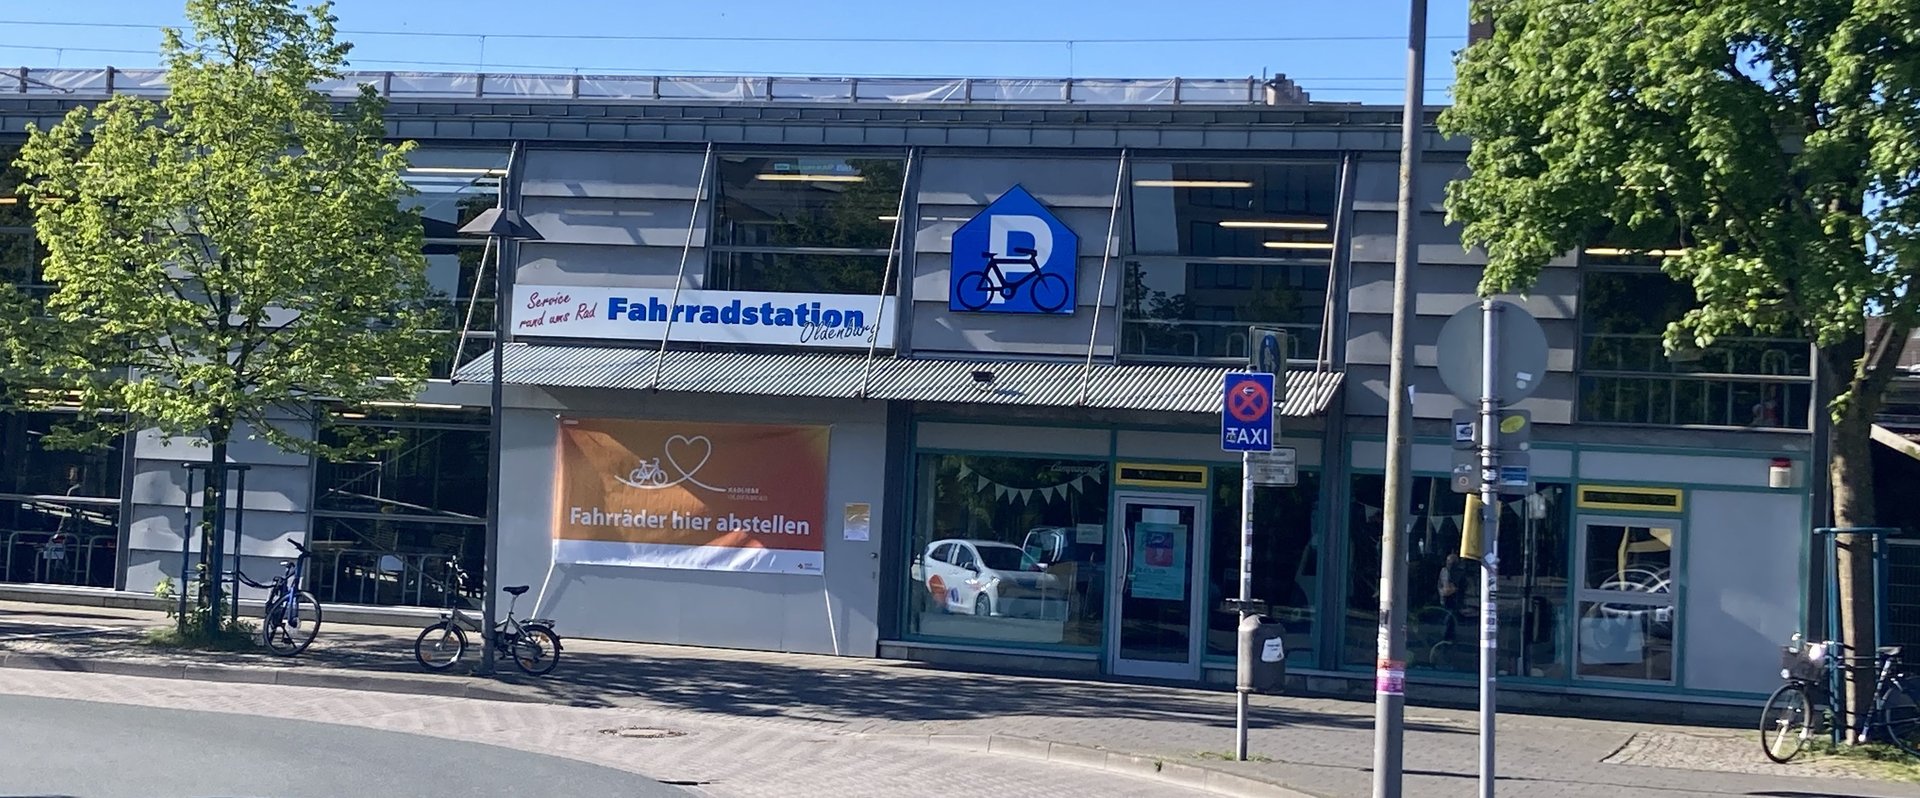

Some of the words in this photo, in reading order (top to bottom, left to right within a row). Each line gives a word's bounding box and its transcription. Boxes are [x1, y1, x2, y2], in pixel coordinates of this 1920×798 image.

[988, 215, 1053, 304] P
[527, 291, 571, 310] Service
[575, 302, 598, 321] Rad
[607, 297, 864, 329] Fahrradstation
[800, 318, 880, 343] Oldenburg
[570, 506, 668, 529] Fahrräder
[671, 511, 711, 531] hier
[716, 512, 810, 536] abstellen
